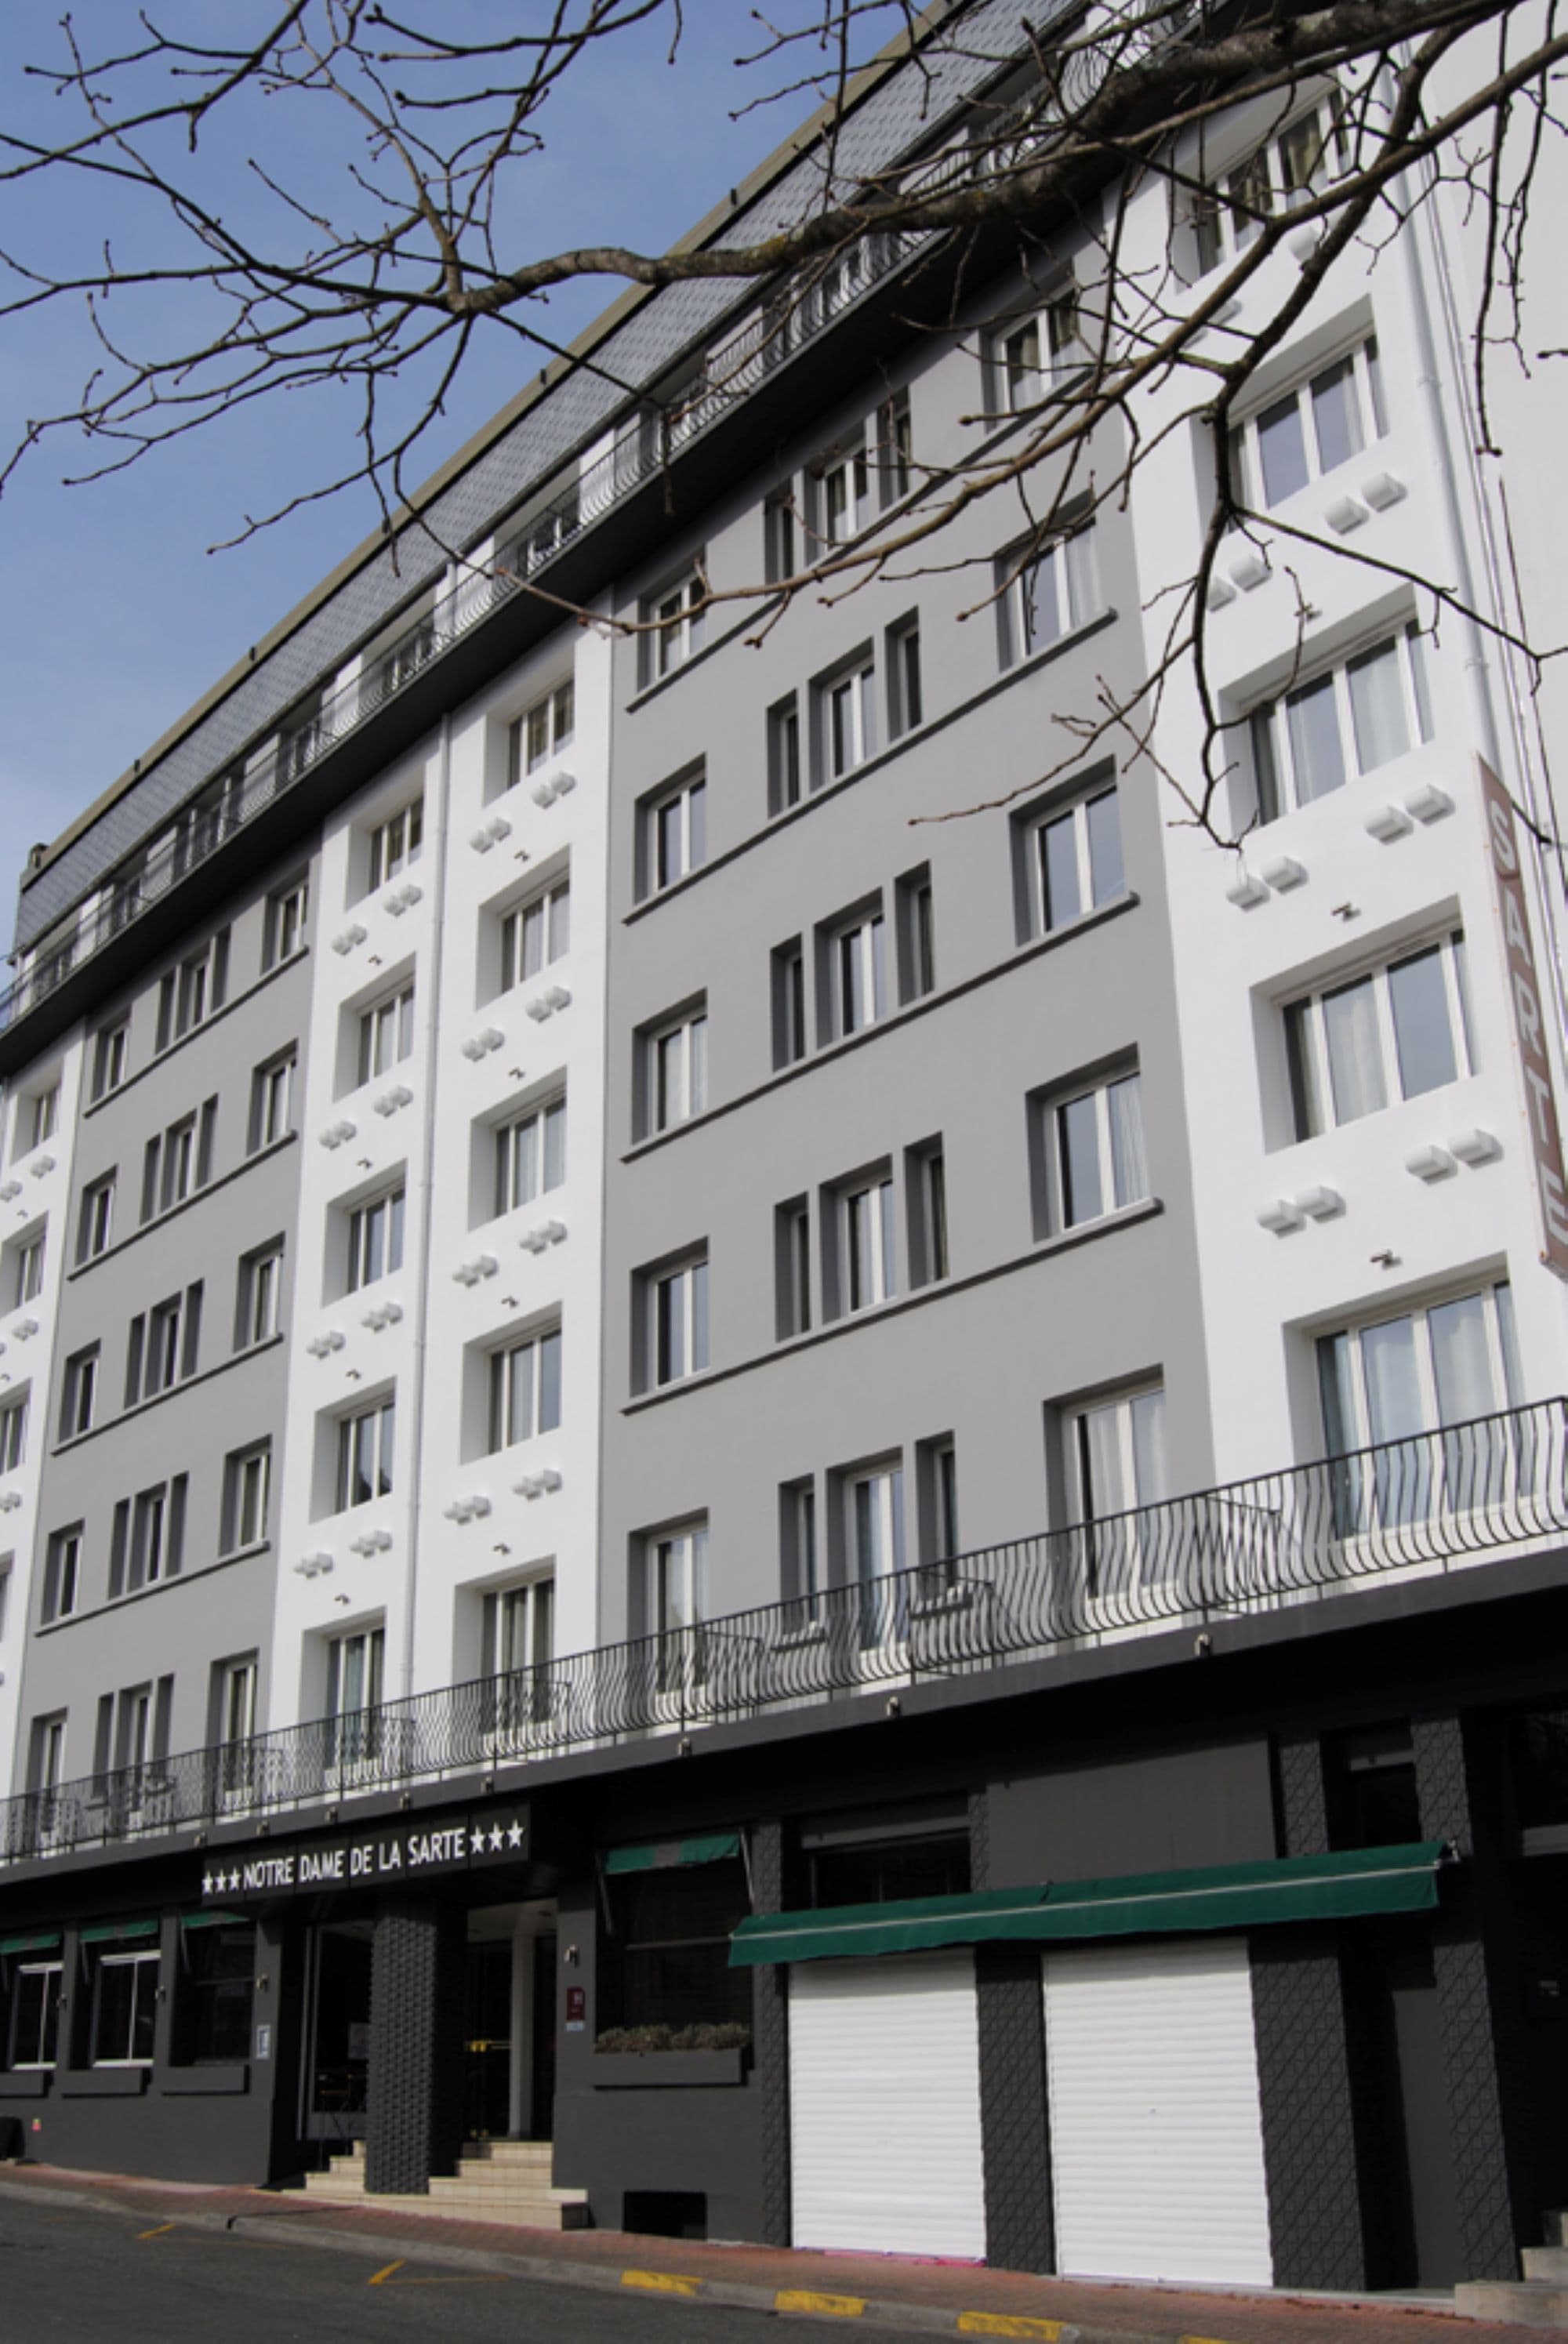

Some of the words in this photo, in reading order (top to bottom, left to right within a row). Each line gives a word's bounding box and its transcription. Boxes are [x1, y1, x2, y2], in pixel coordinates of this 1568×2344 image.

[1490, 799, 1568, 1246] SARTE
[243, 1856, 294, 1890] NOTRE
[300, 1849, 345, 1882] DAME
[350, 1845, 373, 1877] DE
[379, 1840, 401, 1871] LA
[408, 1827, 466, 1866] SARTE
